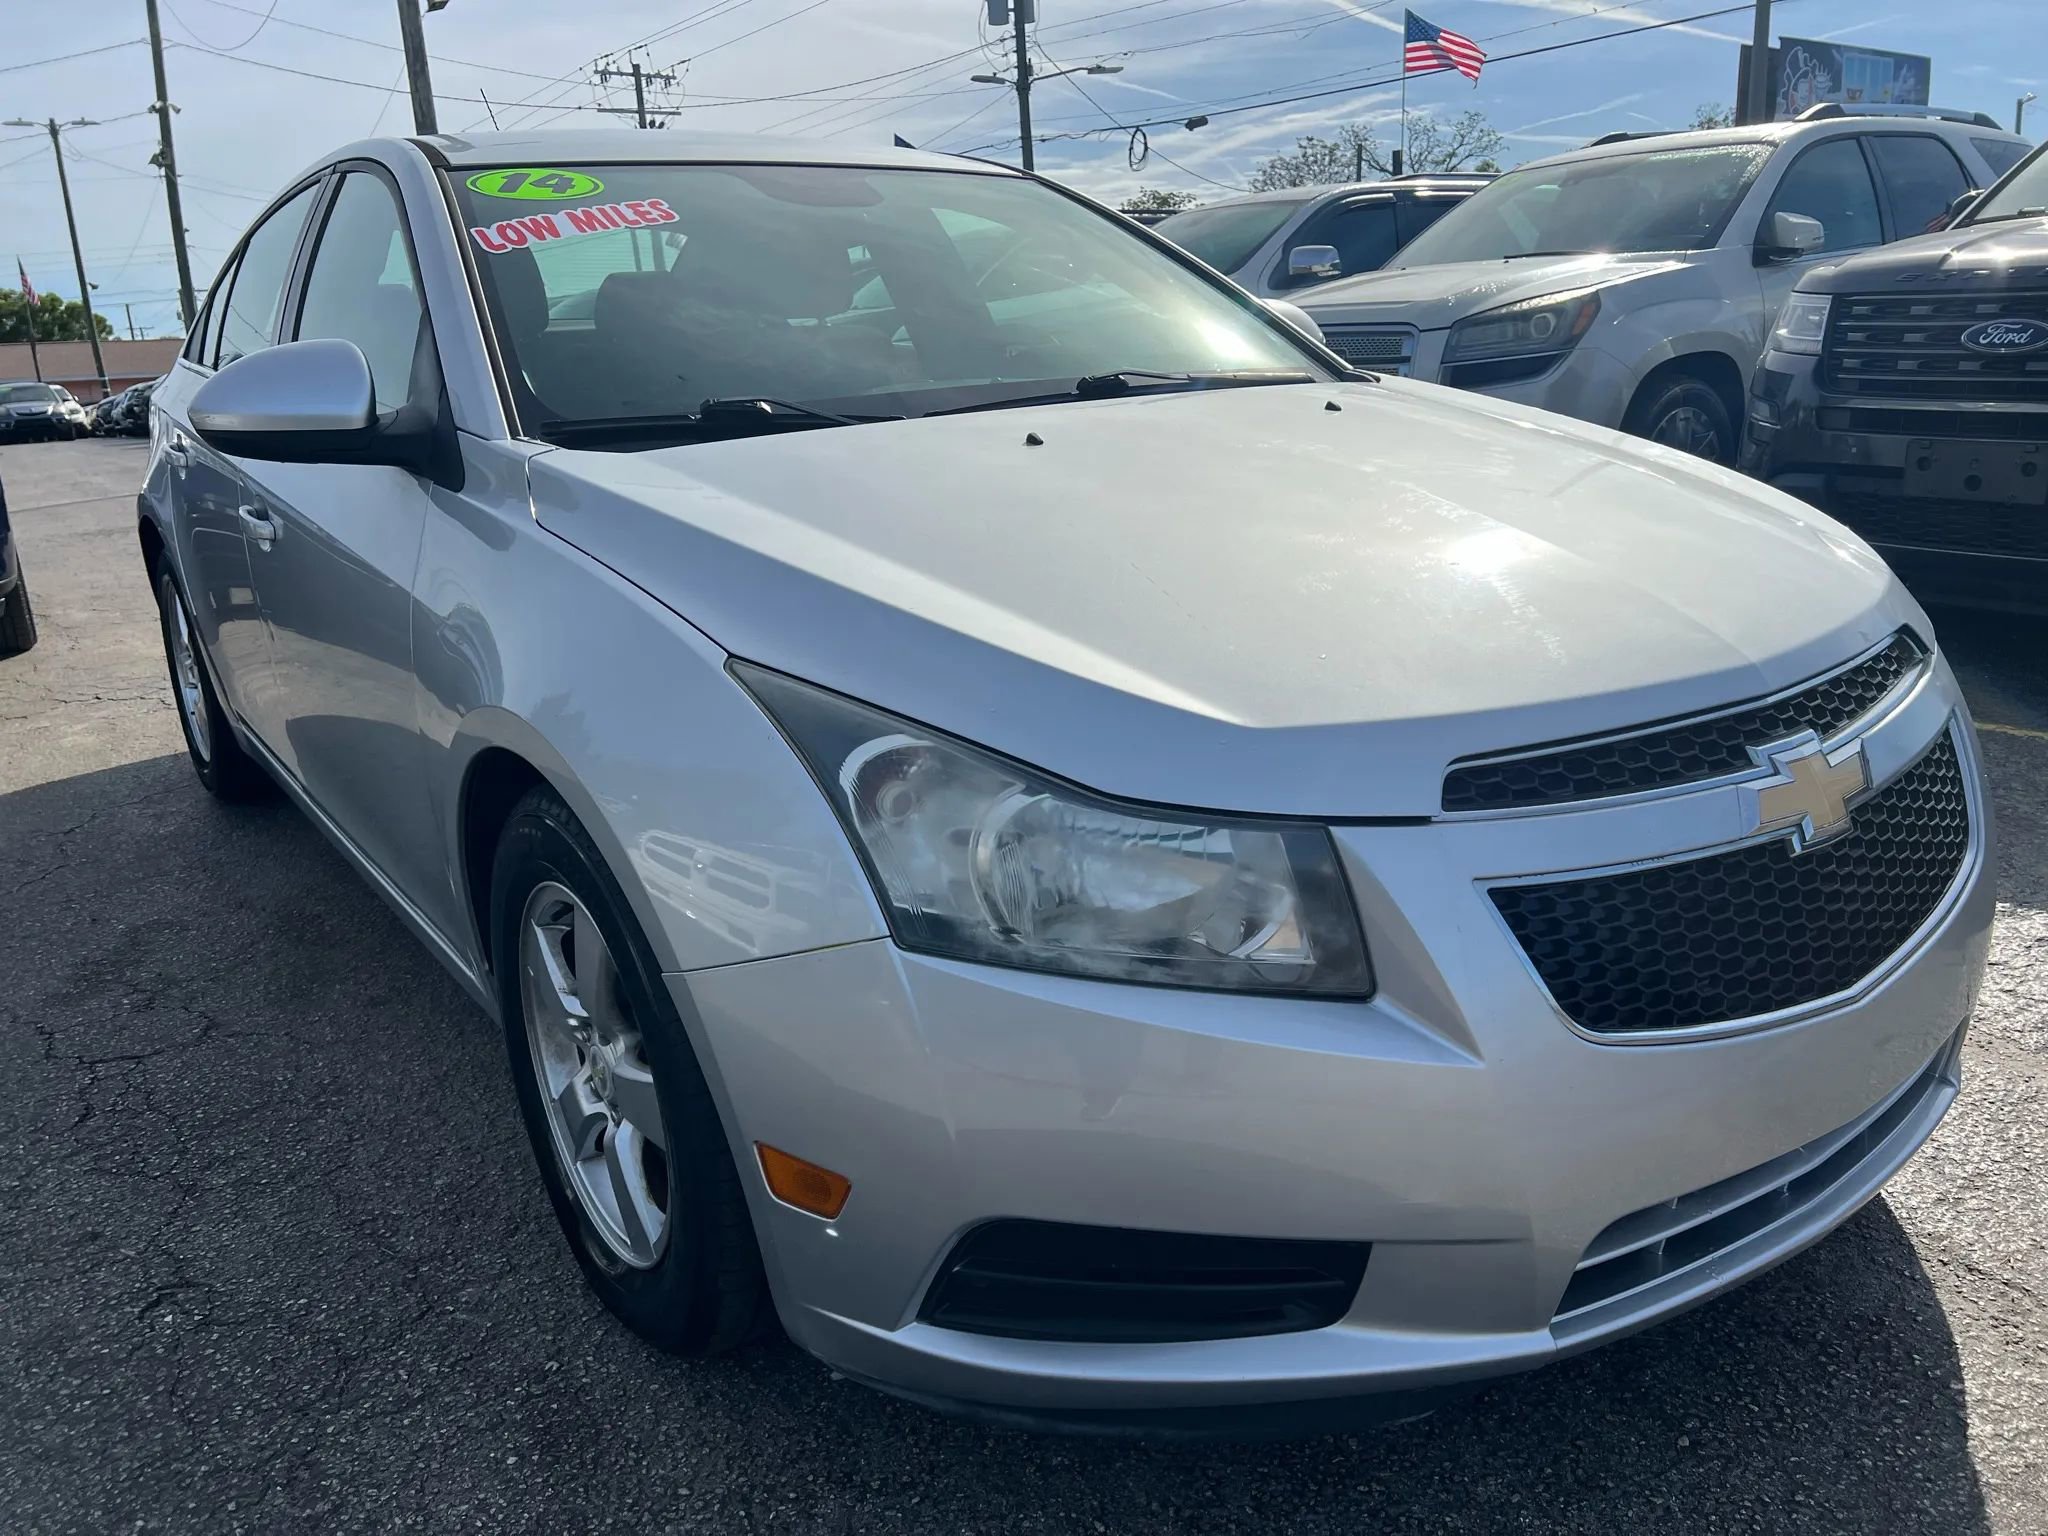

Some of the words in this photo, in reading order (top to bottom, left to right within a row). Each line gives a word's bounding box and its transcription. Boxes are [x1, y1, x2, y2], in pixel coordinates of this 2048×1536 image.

[498, 171, 577, 195] 14
[473, 215, 562, 252] LOW
[564, 199, 678, 234] MILES
[1978, 323, 2034, 344] Ford
